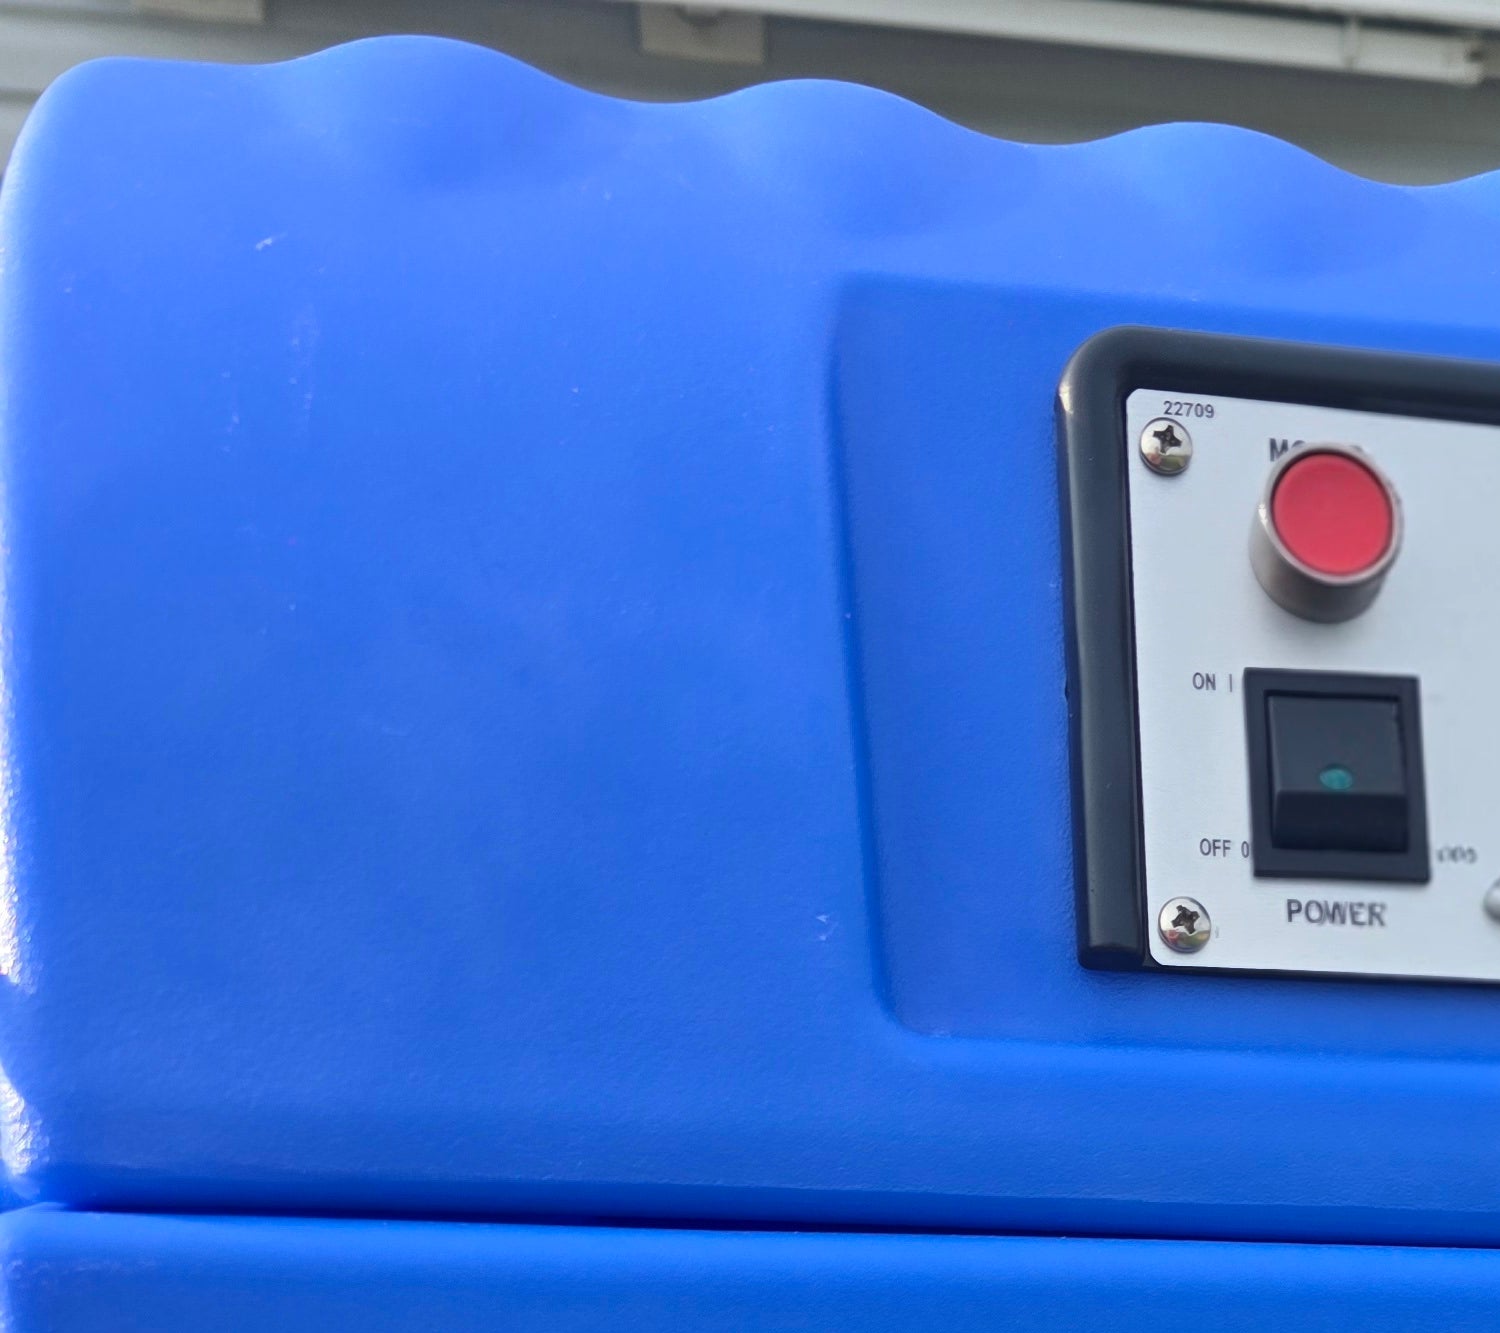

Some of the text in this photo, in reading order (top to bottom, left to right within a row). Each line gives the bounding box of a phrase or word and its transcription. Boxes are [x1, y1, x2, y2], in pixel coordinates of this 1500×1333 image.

[1163, 400, 1215, 418] 22709
[1192, 672, 1217, 691] ON
[1199, 837, 1232, 858] OFF
[1286, 898, 1387, 927] POWER
